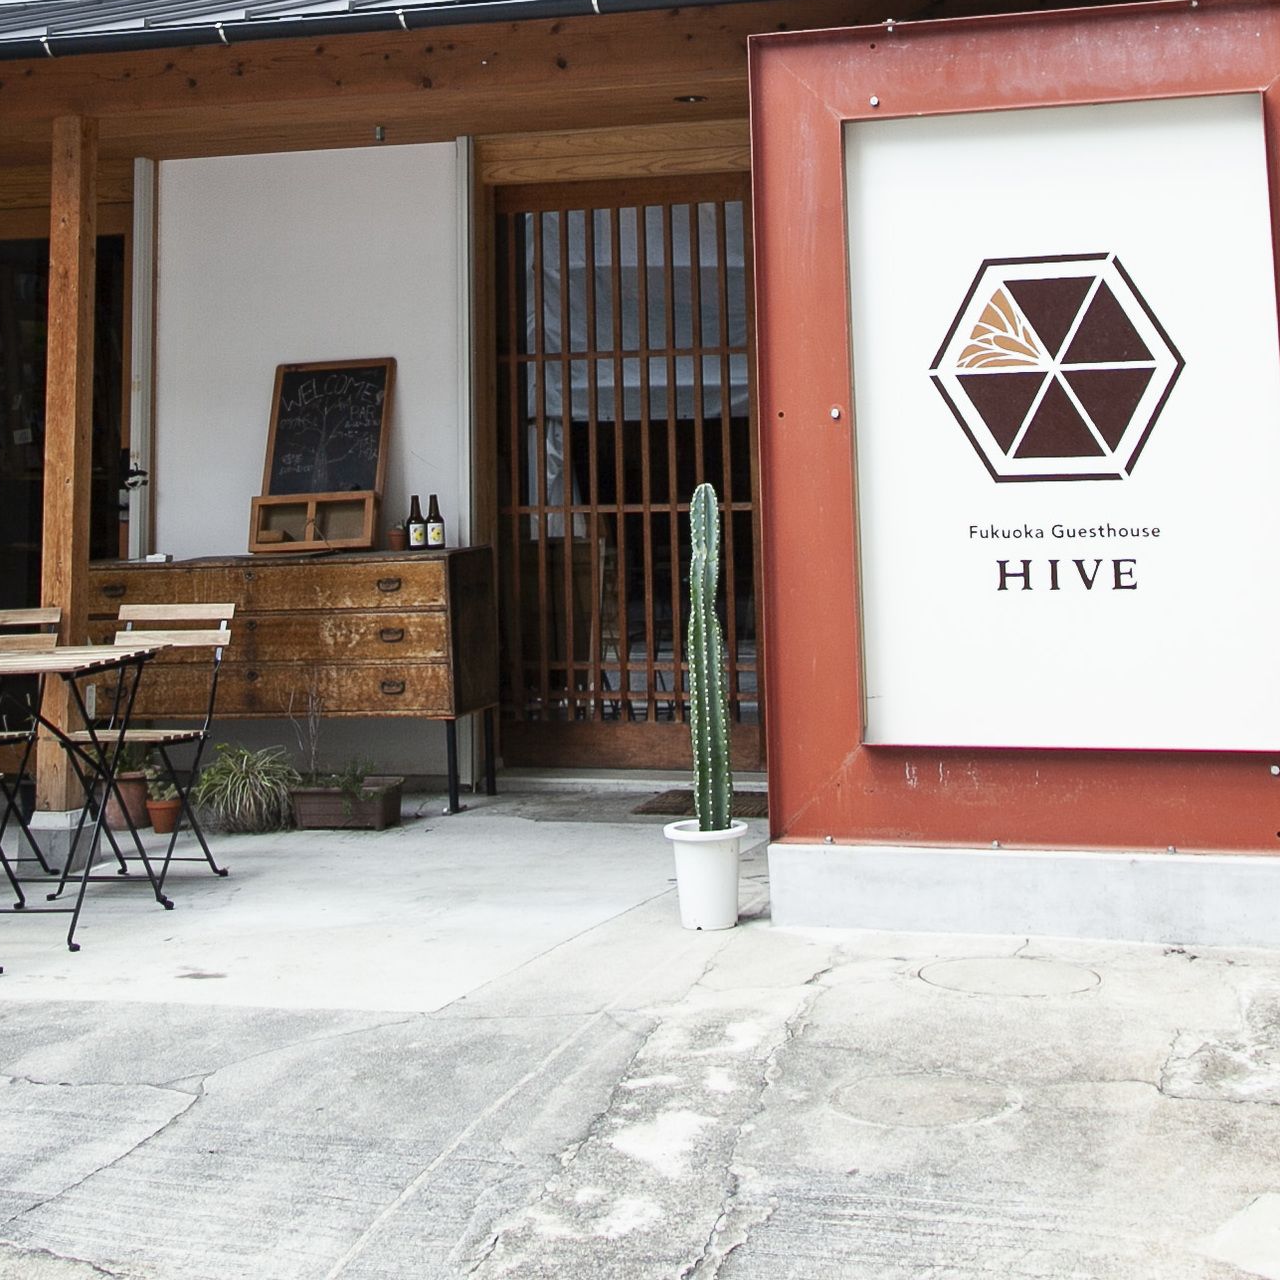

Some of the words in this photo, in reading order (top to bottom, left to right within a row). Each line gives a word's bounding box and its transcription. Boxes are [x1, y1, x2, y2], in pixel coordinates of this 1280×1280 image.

[282, 374, 378, 411] WELCOME
[969, 524, 1044, 539] Fukuoka
[1051, 523, 1161, 539] Guesthouse
[996, 558, 1138, 591] HIVE
